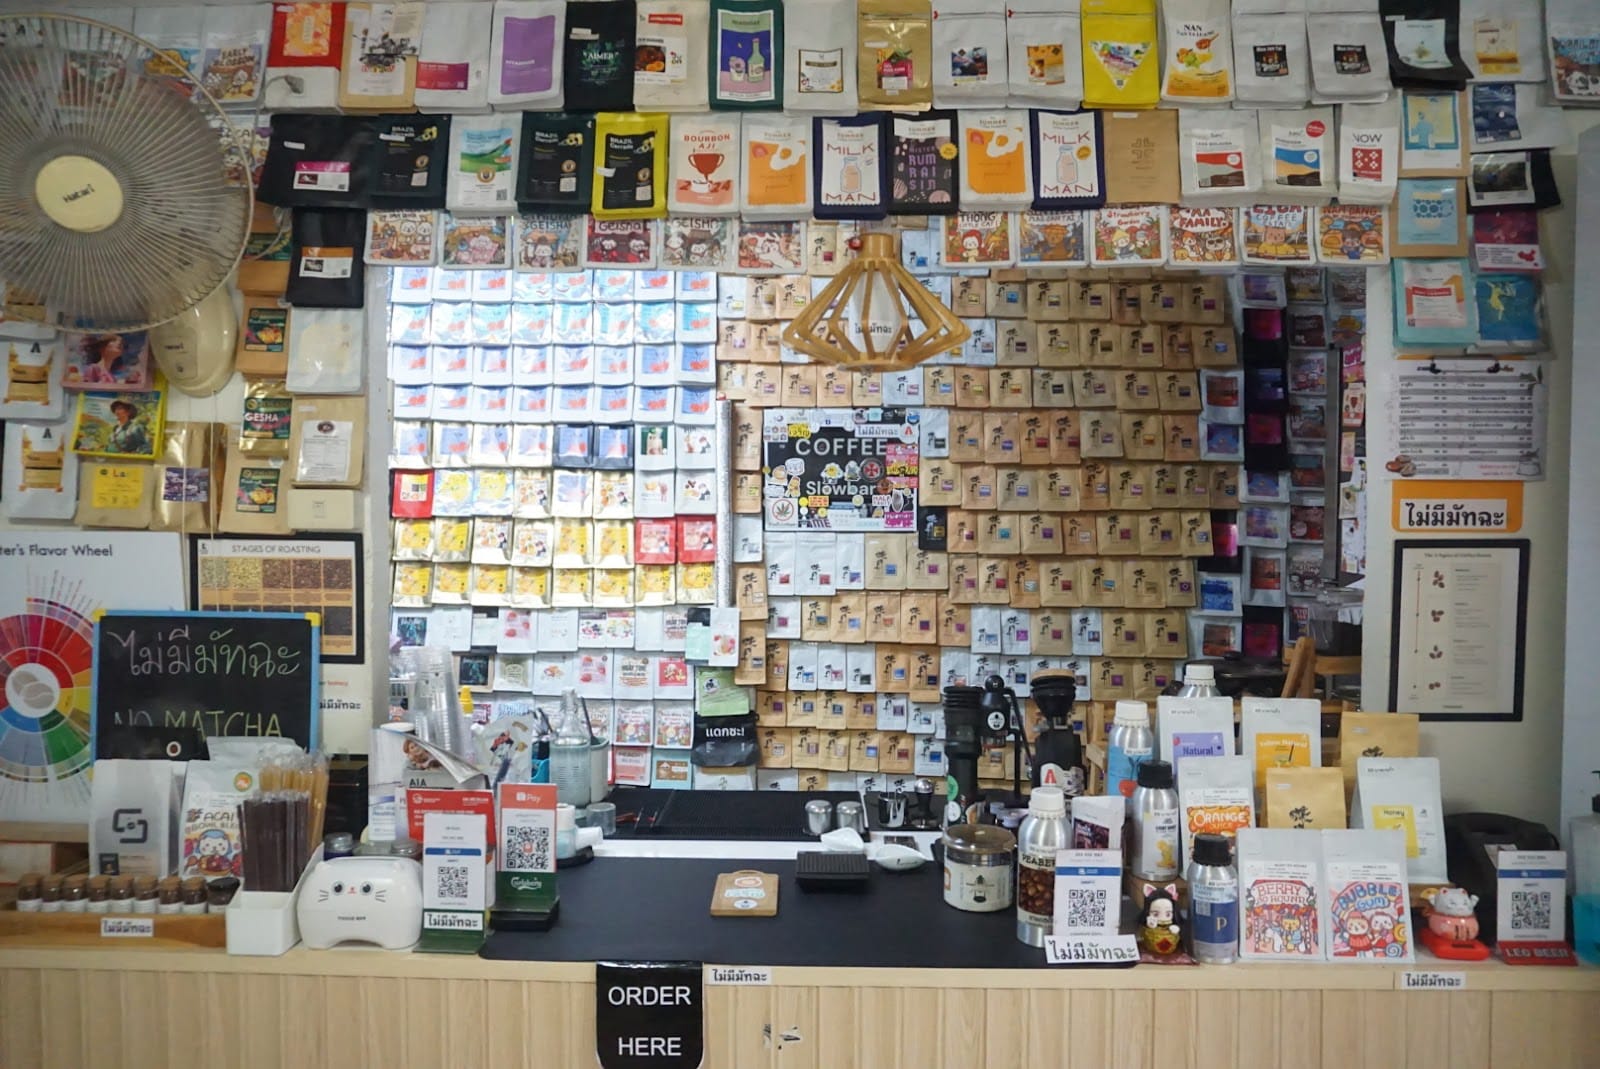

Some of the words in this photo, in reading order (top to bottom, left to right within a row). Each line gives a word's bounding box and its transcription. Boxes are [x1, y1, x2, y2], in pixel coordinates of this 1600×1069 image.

[683, 133, 731, 142] BOURBON
[1042, 131, 1091, 146] MILK
[826, 142, 875, 156] MILK
[908, 154, 937, 166] RUM
[1042, 183, 1094, 195] MAN
[825, 191, 877, 203] MAN
[1179, 216, 1224, 228] FAMILY
[243, 412, 279, 423] GESHA
[795, 437, 888, 457] COFFEE
[806, 480, 877, 496] Slowbar
[1405, 502, 1505, 527] ไม่มีมัทฉะ
[29, 544, 67, 557] Flavor
[72, 544, 113, 557] Wheel
[231, 545, 264, 554] STAGES
[277, 545, 321, 554] ROASTING
[107, 624, 300, 678] ไม่มีมัทฉะ
[165, 709, 283, 742] MATCHA
[1182, 746, 1214, 757] Natural
[409, 778, 428, 788] AIA
[1193, 810, 1249, 828] ORANGE
[1383, 808, 1406, 817] Honey
[1257, 883, 1302, 898] BERRY
[1338, 882, 1398, 910] BUBBLE
[1355, 897, 1387, 912] GUM
[427, 913, 479, 928] ไม่มีมัทฉะ
[1048, 939, 1138, 962] ไม่มีมัทฉะ
[712, 968, 768, 983] ไม่มีมัทฉะ
[1405, 972, 1462, 988] ไม่มีมัทฉะ
[607, 986, 693, 1006] ORDER
[617, 1036, 682, 1057] HERE
